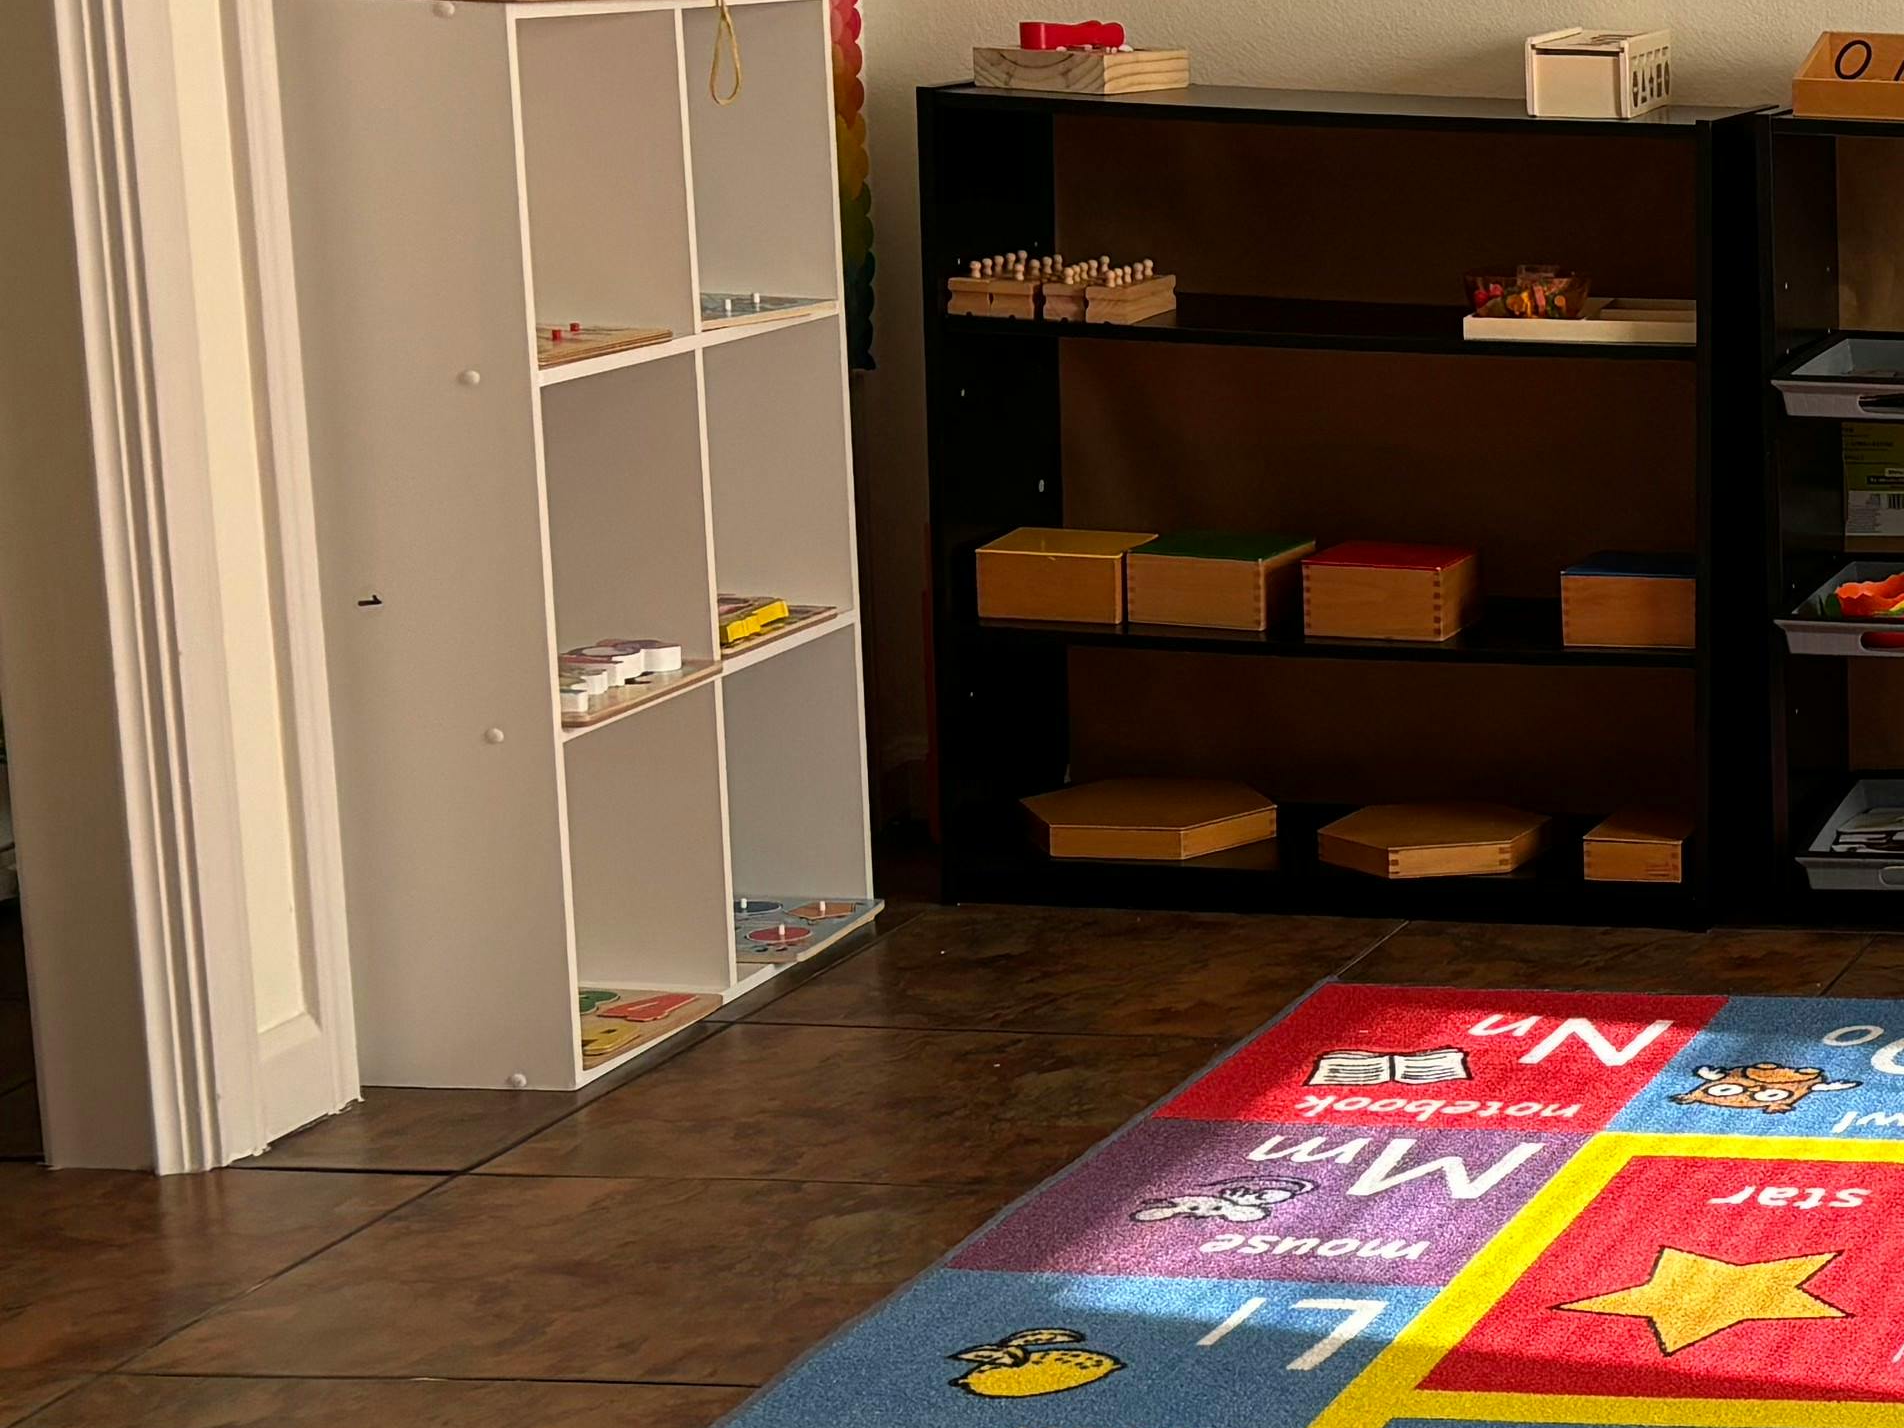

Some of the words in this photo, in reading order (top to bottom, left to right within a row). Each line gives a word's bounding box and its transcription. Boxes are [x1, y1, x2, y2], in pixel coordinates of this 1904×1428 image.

[1835, 40, 1872, 80] 0
[1296, 1095, 1581, 1121] notebook
[1710, 1186, 1877, 1209] star
[1200, 1233, 1429, 1266] mouse
